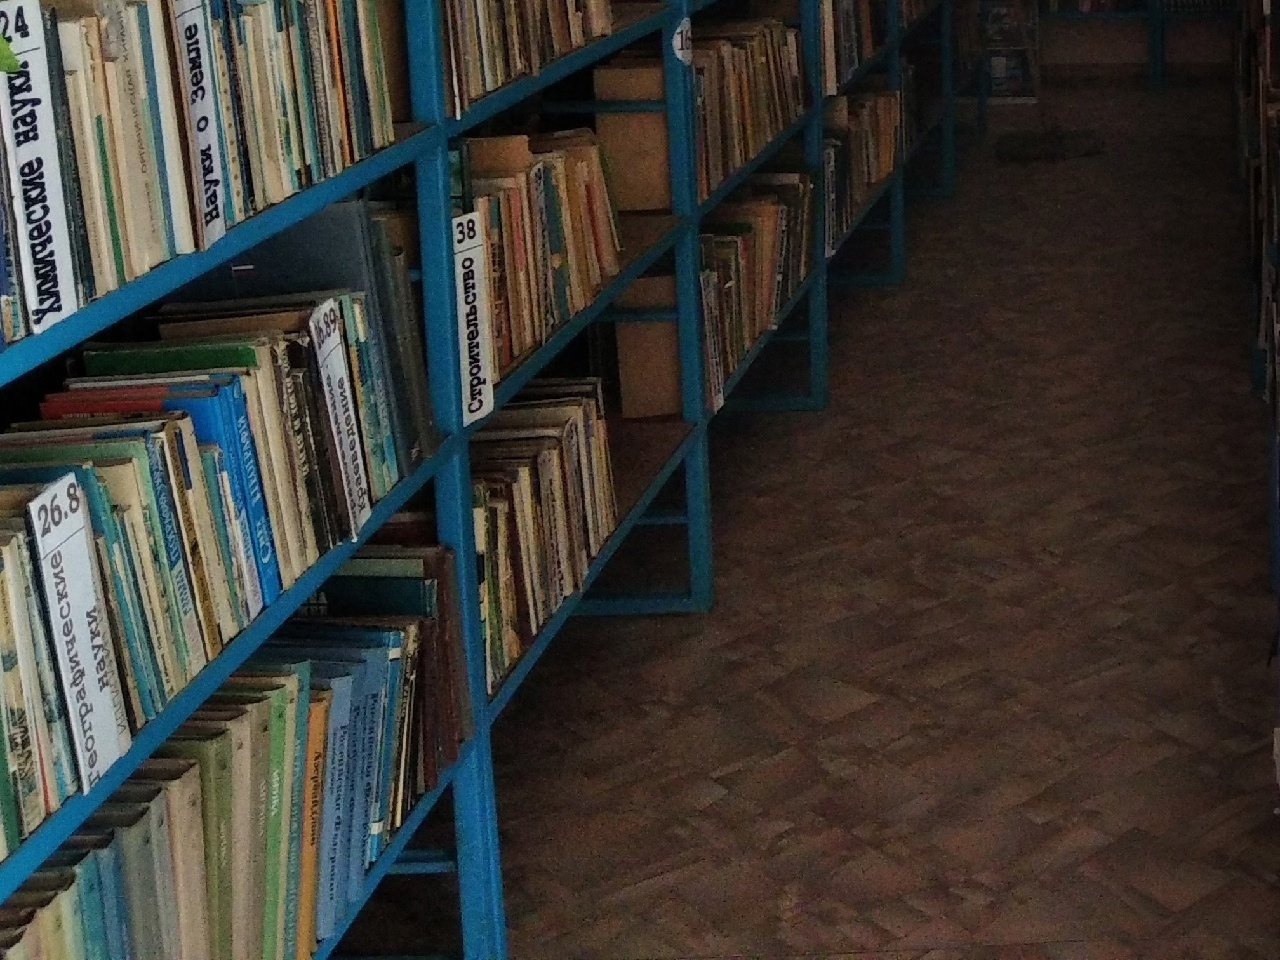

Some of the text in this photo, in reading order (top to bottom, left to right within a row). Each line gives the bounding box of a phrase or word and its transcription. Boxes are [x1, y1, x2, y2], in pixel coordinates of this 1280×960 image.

[182, 23, 220, 226] Науки о Земле
[20, 158, 62, 324] Химические
[456, 219, 476, 245] 38
[461, 257, 486, 413] Строительство
[37, 483, 81, 538] 26.8
[336, 377, 366, 513] Краеведение
[83, 605, 110, 692] науки
